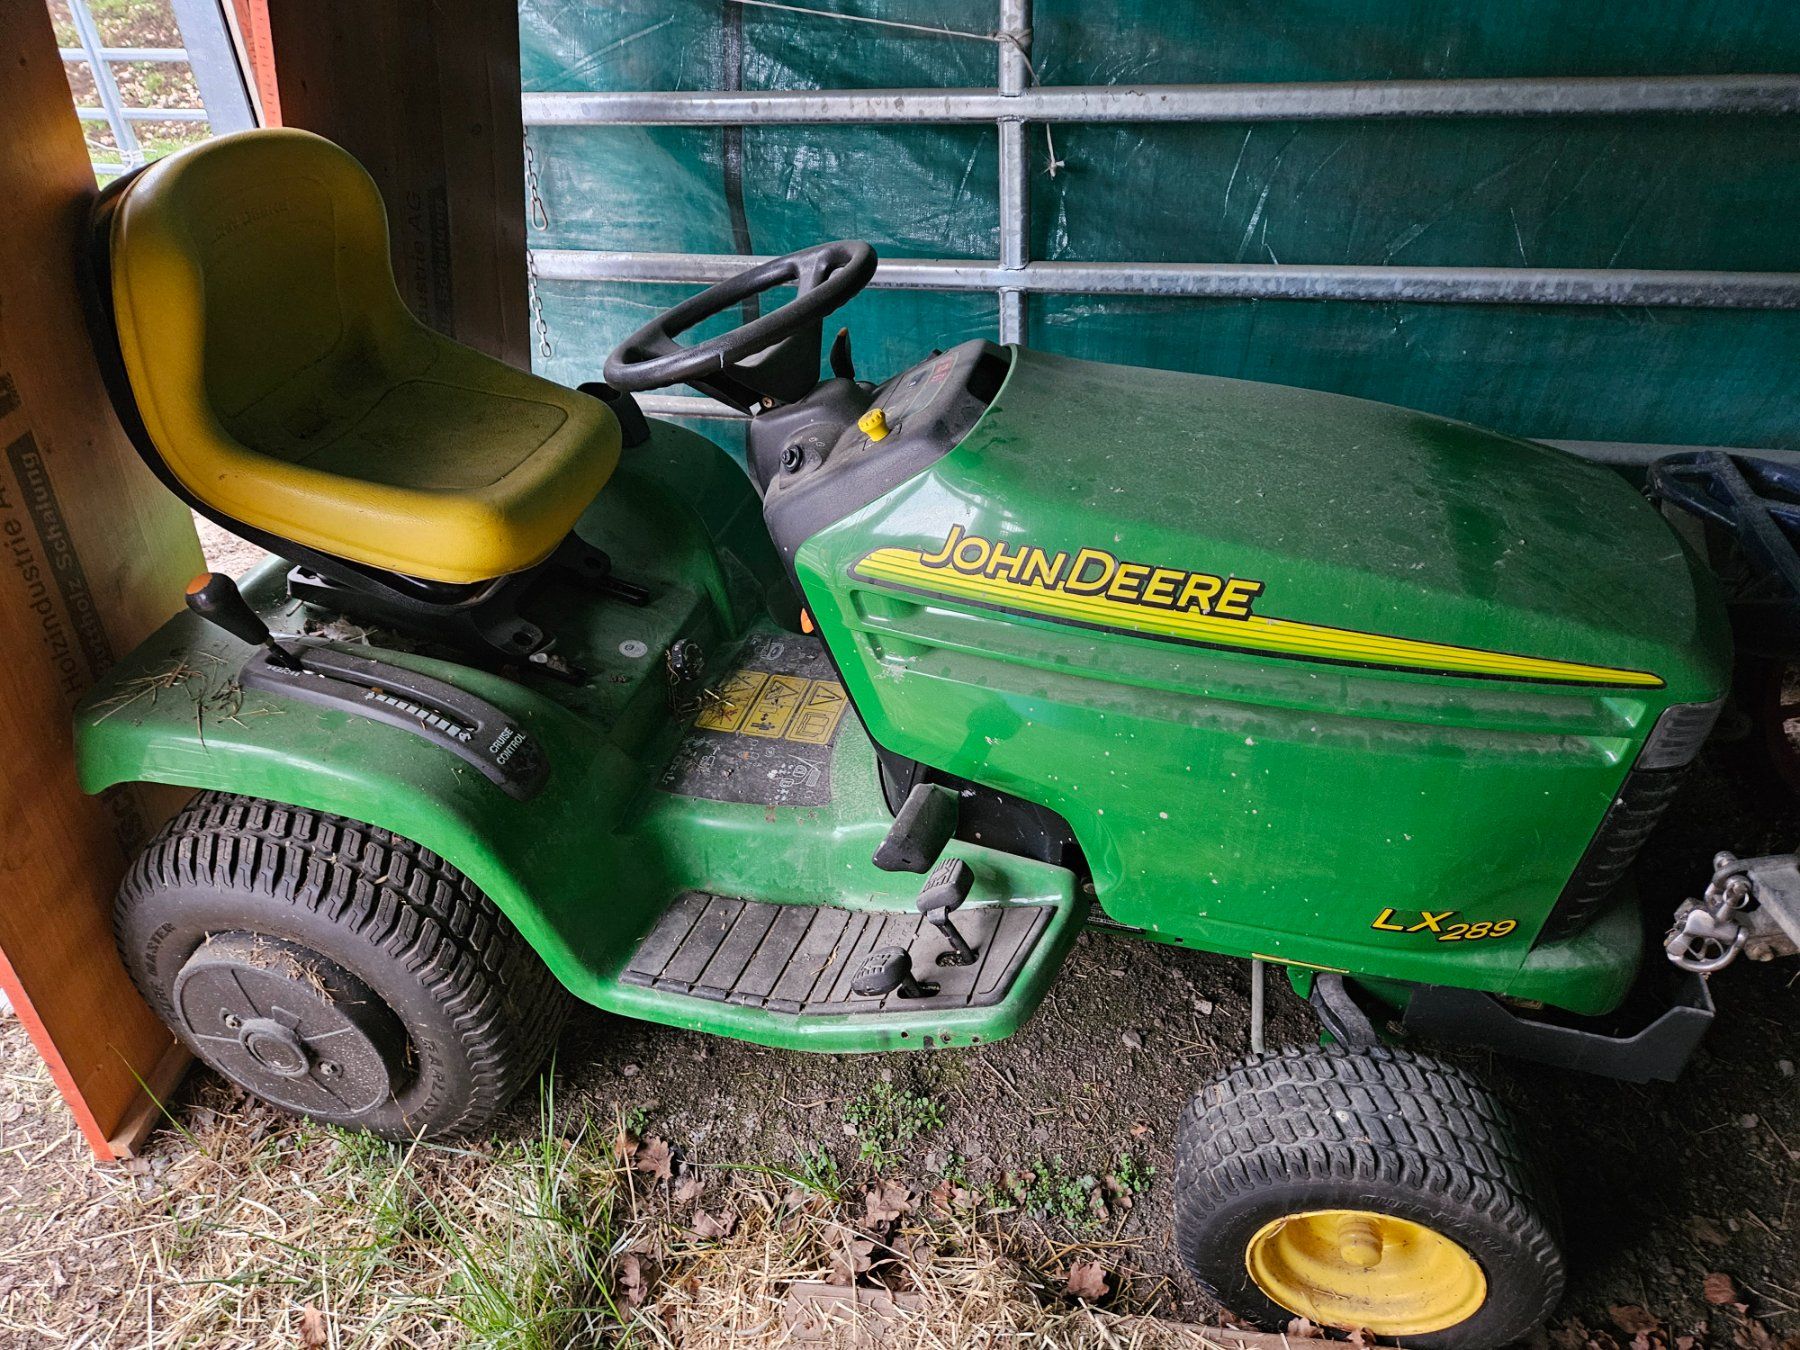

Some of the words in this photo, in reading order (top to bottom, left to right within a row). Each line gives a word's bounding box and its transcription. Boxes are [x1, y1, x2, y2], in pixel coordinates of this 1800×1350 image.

[21, 451, 75, 571] Schalung
[4, 518, 83, 697] Holzindustrie
[920, 524, 1069, 589] JOHN
[1064, 547, 1265, 621] DEERE
[489, 726, 513, 753] CRUISE
[496, 733, 526, 765] CONTROL
[144, 921, 177, 977] MASTER
